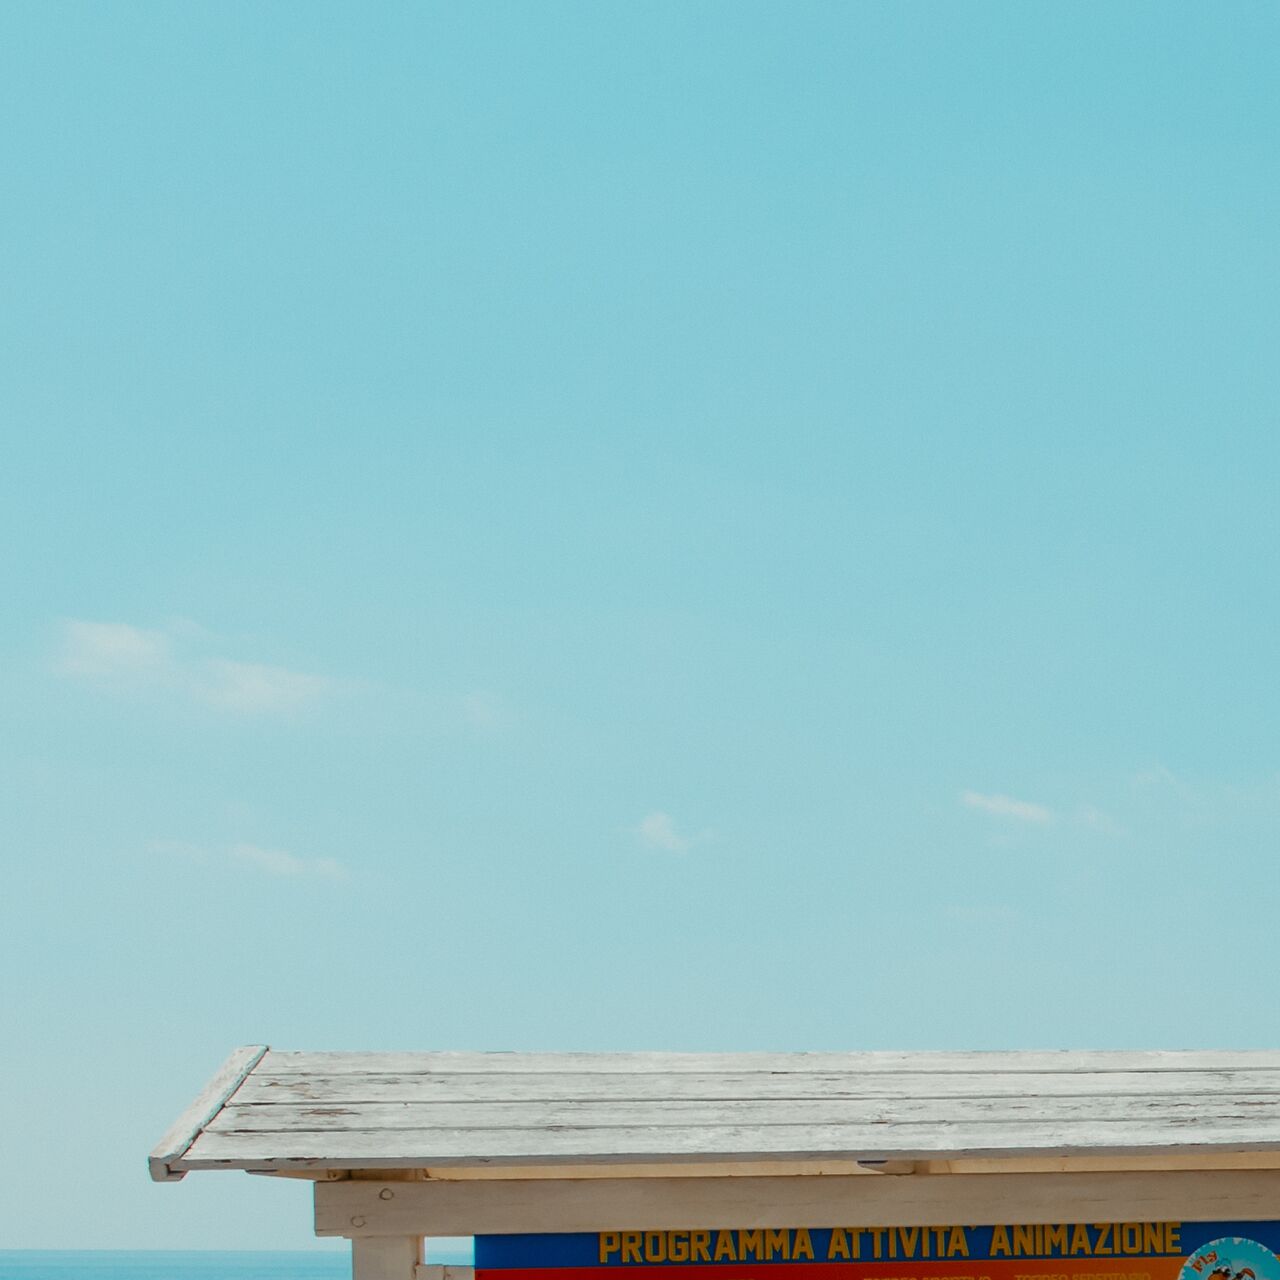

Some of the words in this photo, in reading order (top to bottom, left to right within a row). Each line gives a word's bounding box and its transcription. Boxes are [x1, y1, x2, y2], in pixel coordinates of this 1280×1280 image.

[599, 1228, 815, 1263] PROGRAMMA
[990, 1222, 1182, 1257] ANIMAZIONE
[1191, 1250, 1218, 1273] Fly
